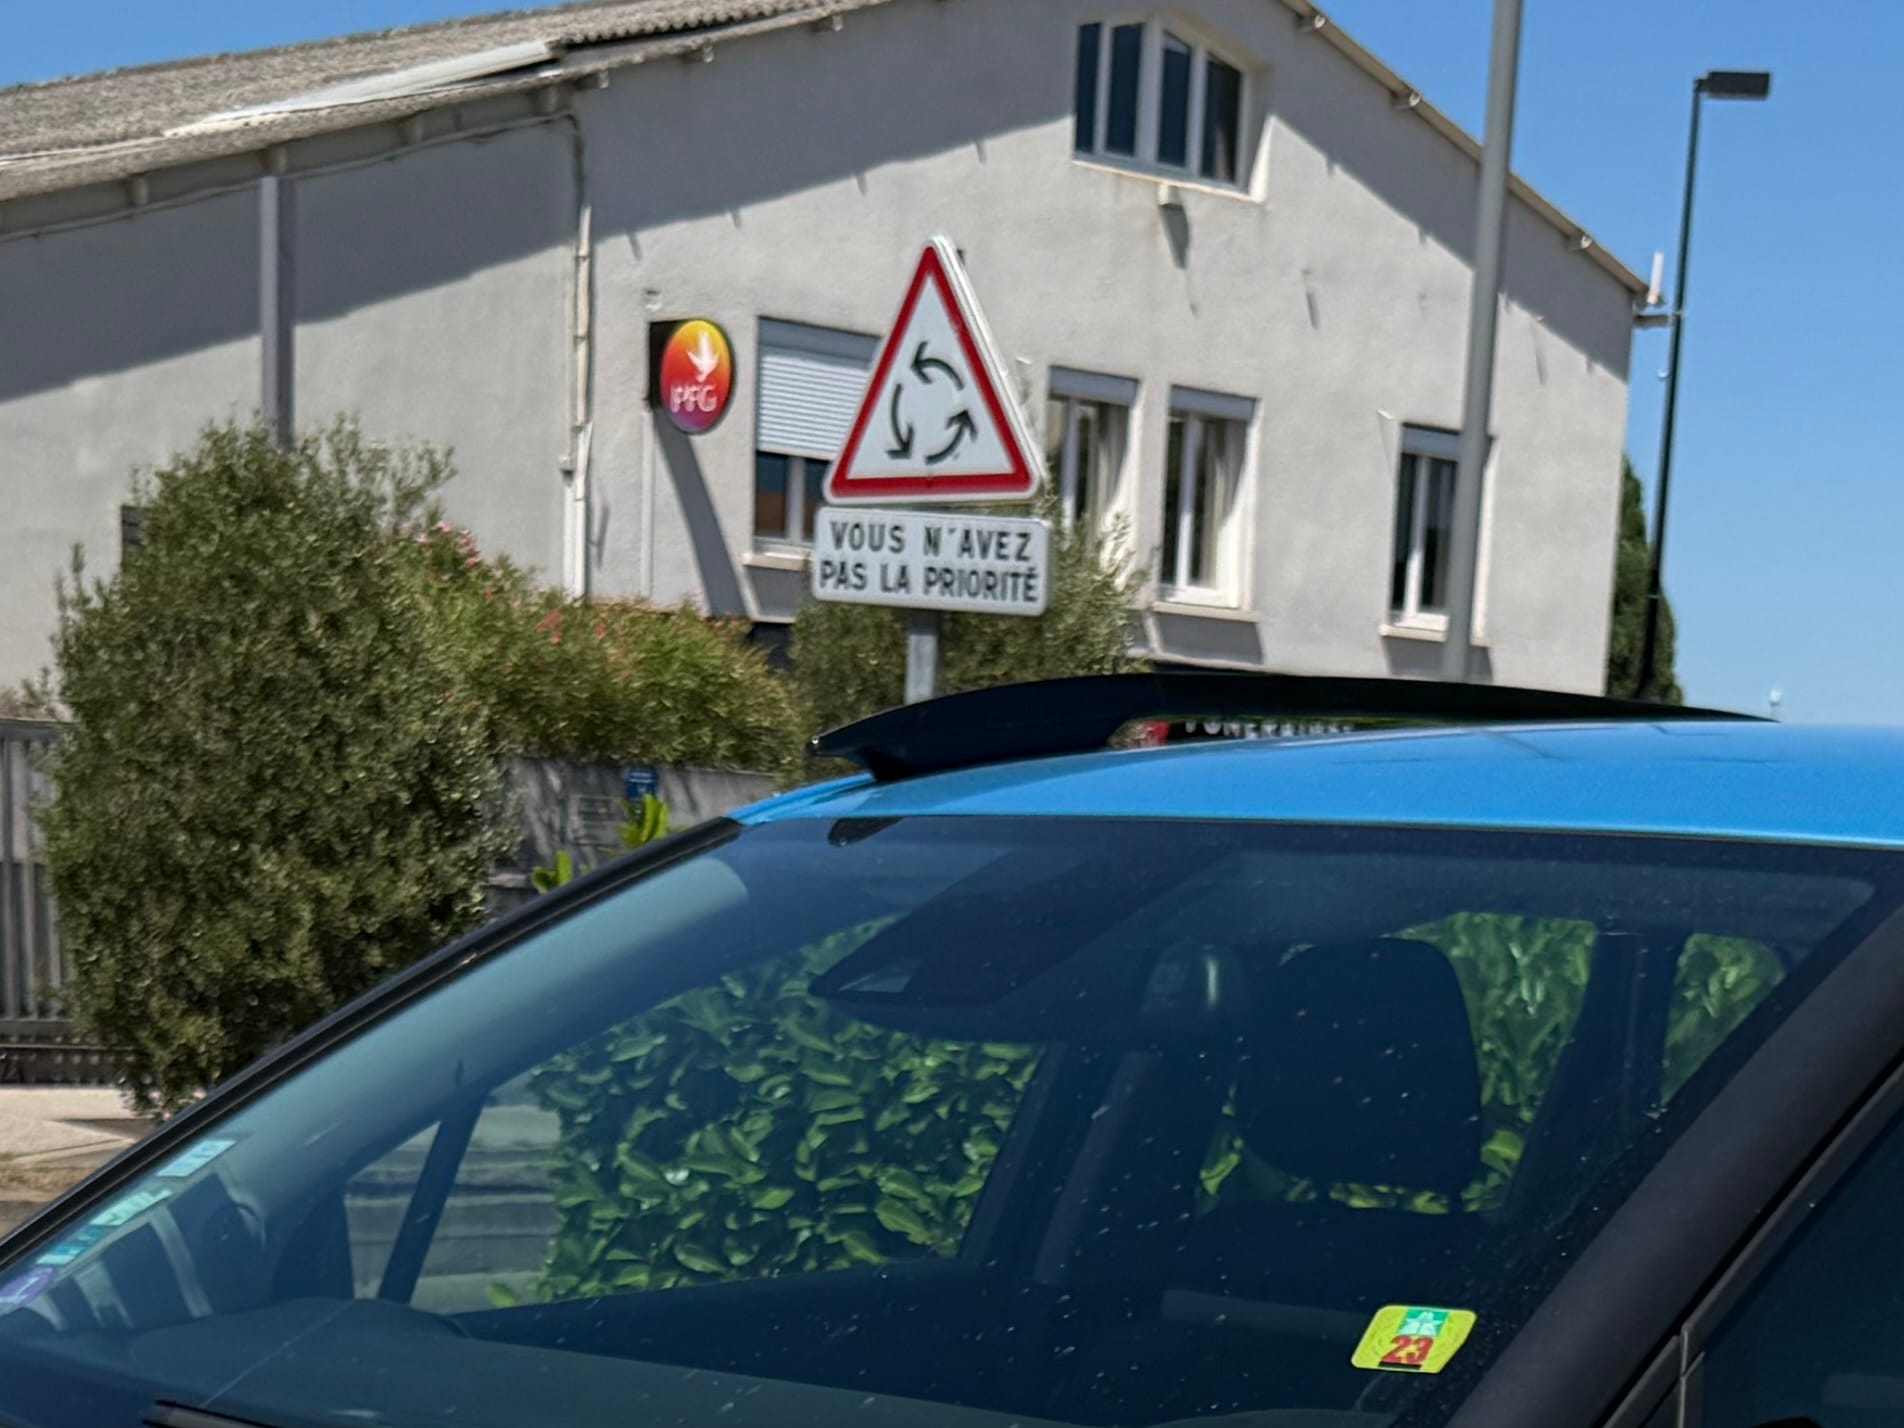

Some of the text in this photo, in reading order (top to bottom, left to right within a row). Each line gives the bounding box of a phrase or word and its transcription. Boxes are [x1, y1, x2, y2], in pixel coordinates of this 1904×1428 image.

[670, 383, 718, 413] PFG
[830, 520, 1032, 562] VOUS N'AVEZ
[819, 560, 1039, 602] PAS LA PRIORITÉ
